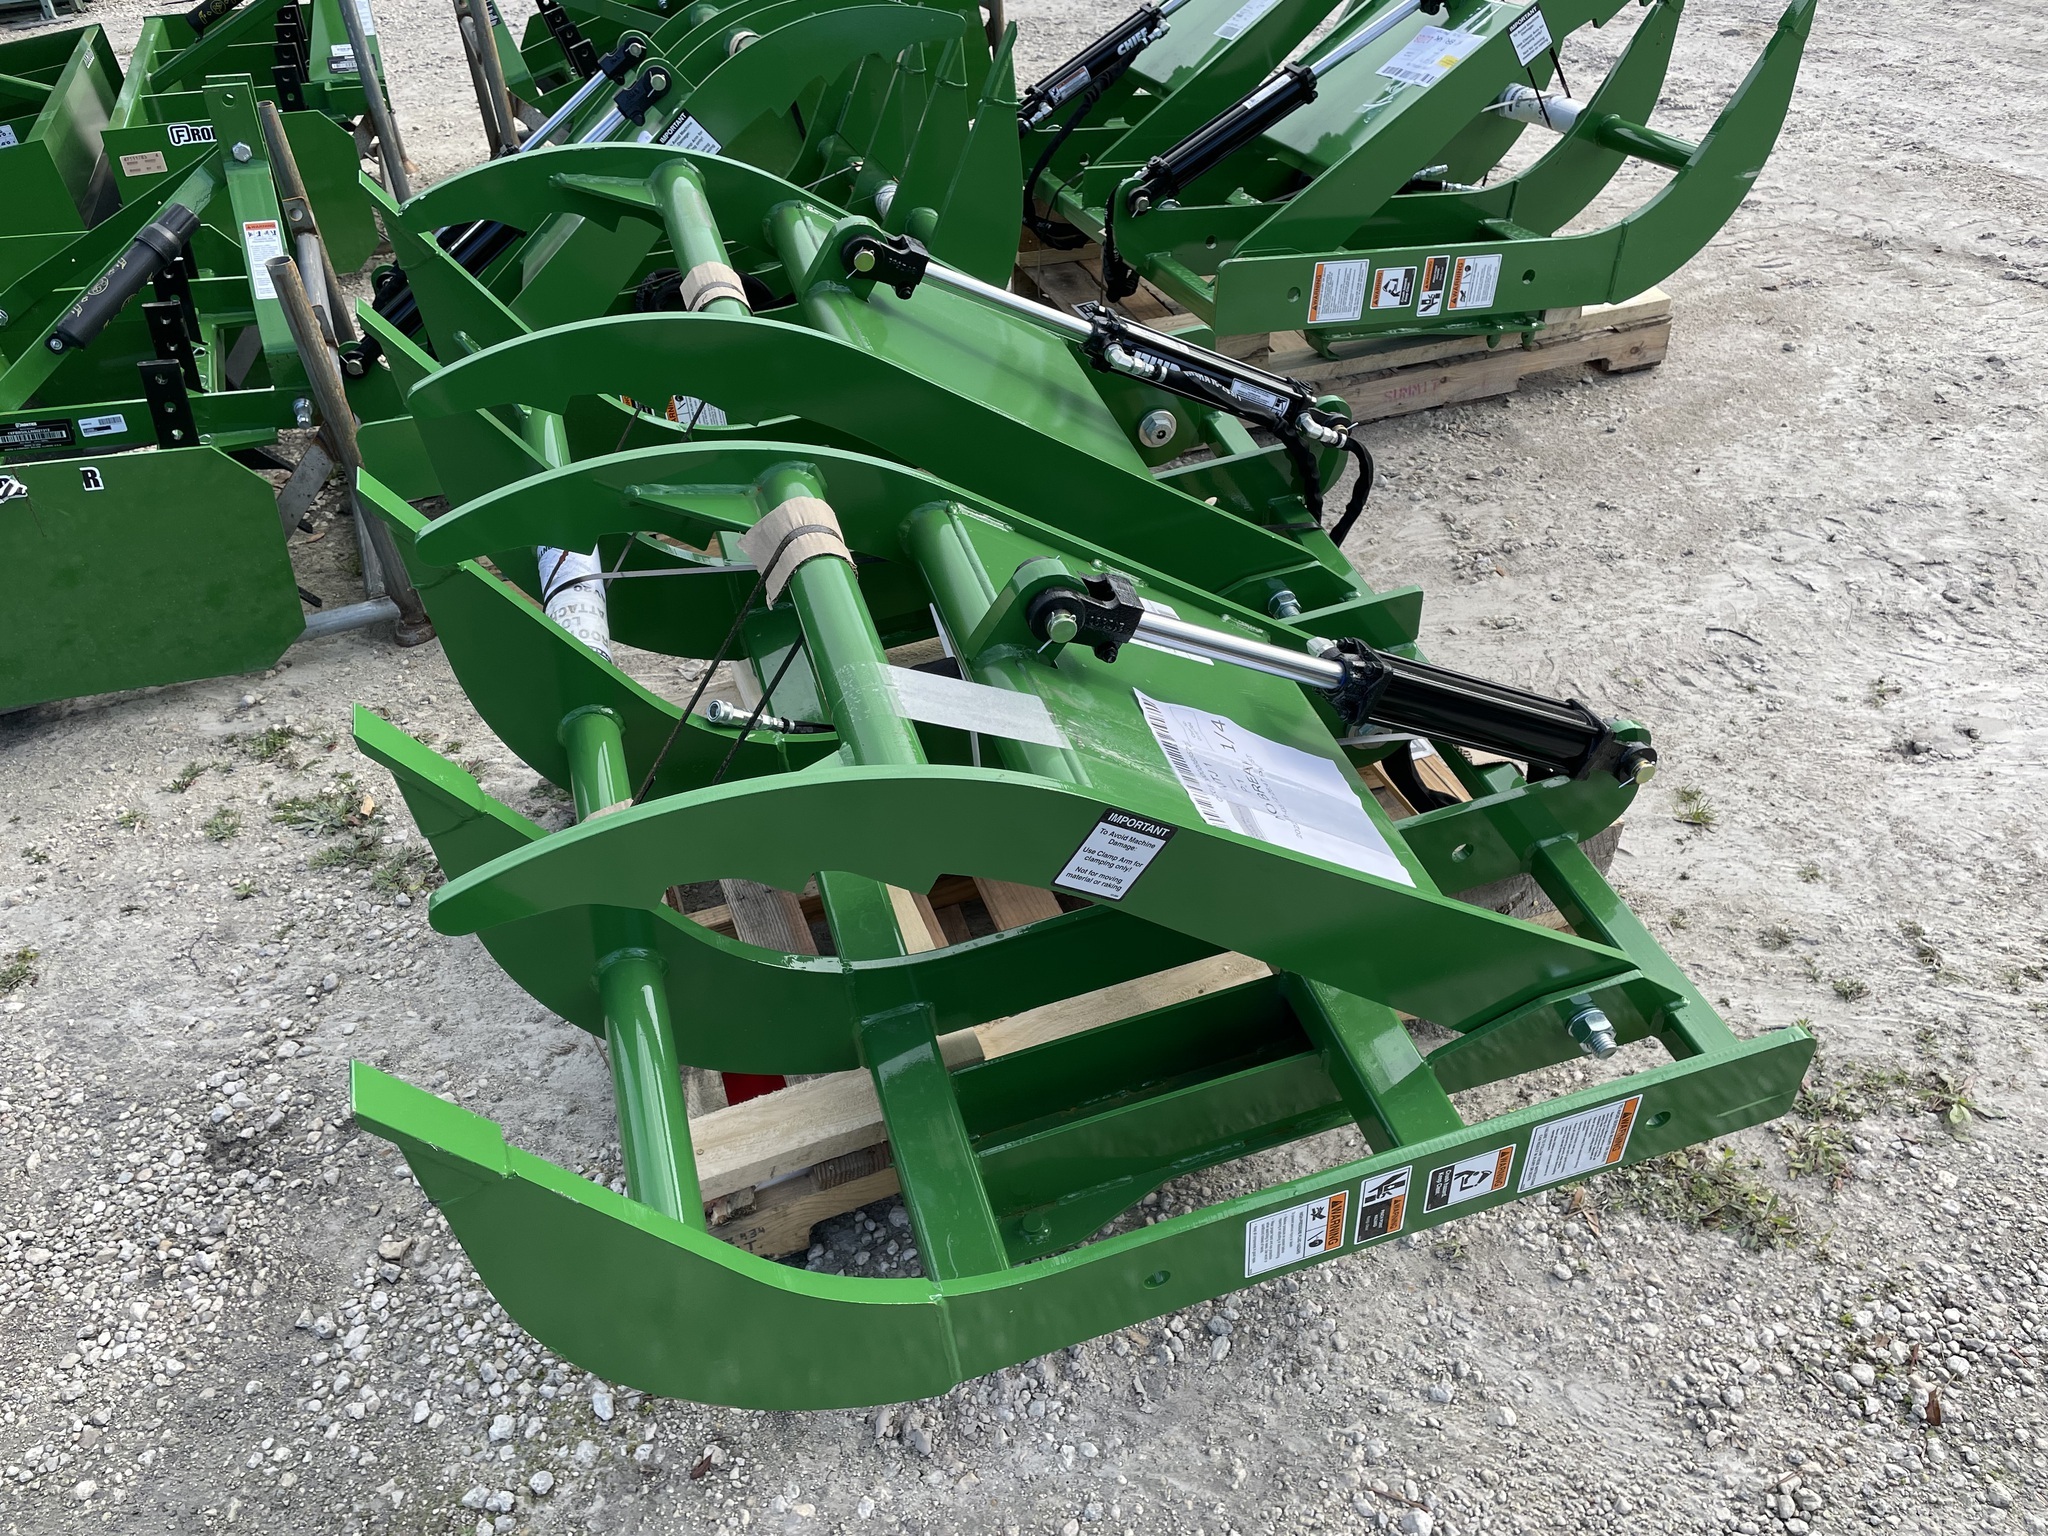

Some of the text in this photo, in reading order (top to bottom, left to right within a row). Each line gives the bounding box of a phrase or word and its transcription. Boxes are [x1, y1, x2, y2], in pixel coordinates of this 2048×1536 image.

[1509, 6, 1537, 32] IMPORTANT
[660, 112, 686, 144] IMPORTANT
[1313, 274, 1322, 306] WARNING
[1454, 262, 1463, 298] WARNING
[80, 468, 103, 490] R
[1211, 720, 1236, 752] 1/4
[1108, 812, 1170, 836] IMPORTANT
[1108, 831, 1128, 841] Avoid
[1128, 836, 1156, 849] Machine
[1108, 839, 1138, 851] Damage:
[1083, 846, 1096, 855] Use
[1097, 850, 1118, 861] Clamp
[1119, 856, 1133, 866] Arm
[1084, 855, 1132, 872] clamping only!
[1066, 872, 1093, 883] material
[1101, 880, 1122, 892] raking
[1100, 873, 1123, 884] moving
[1612, 1119, 1629, 1152] WARNING
[1495, 1157, 1507, 1187] WARNING
[1328, 1208, 1342, 1245] WARNING
